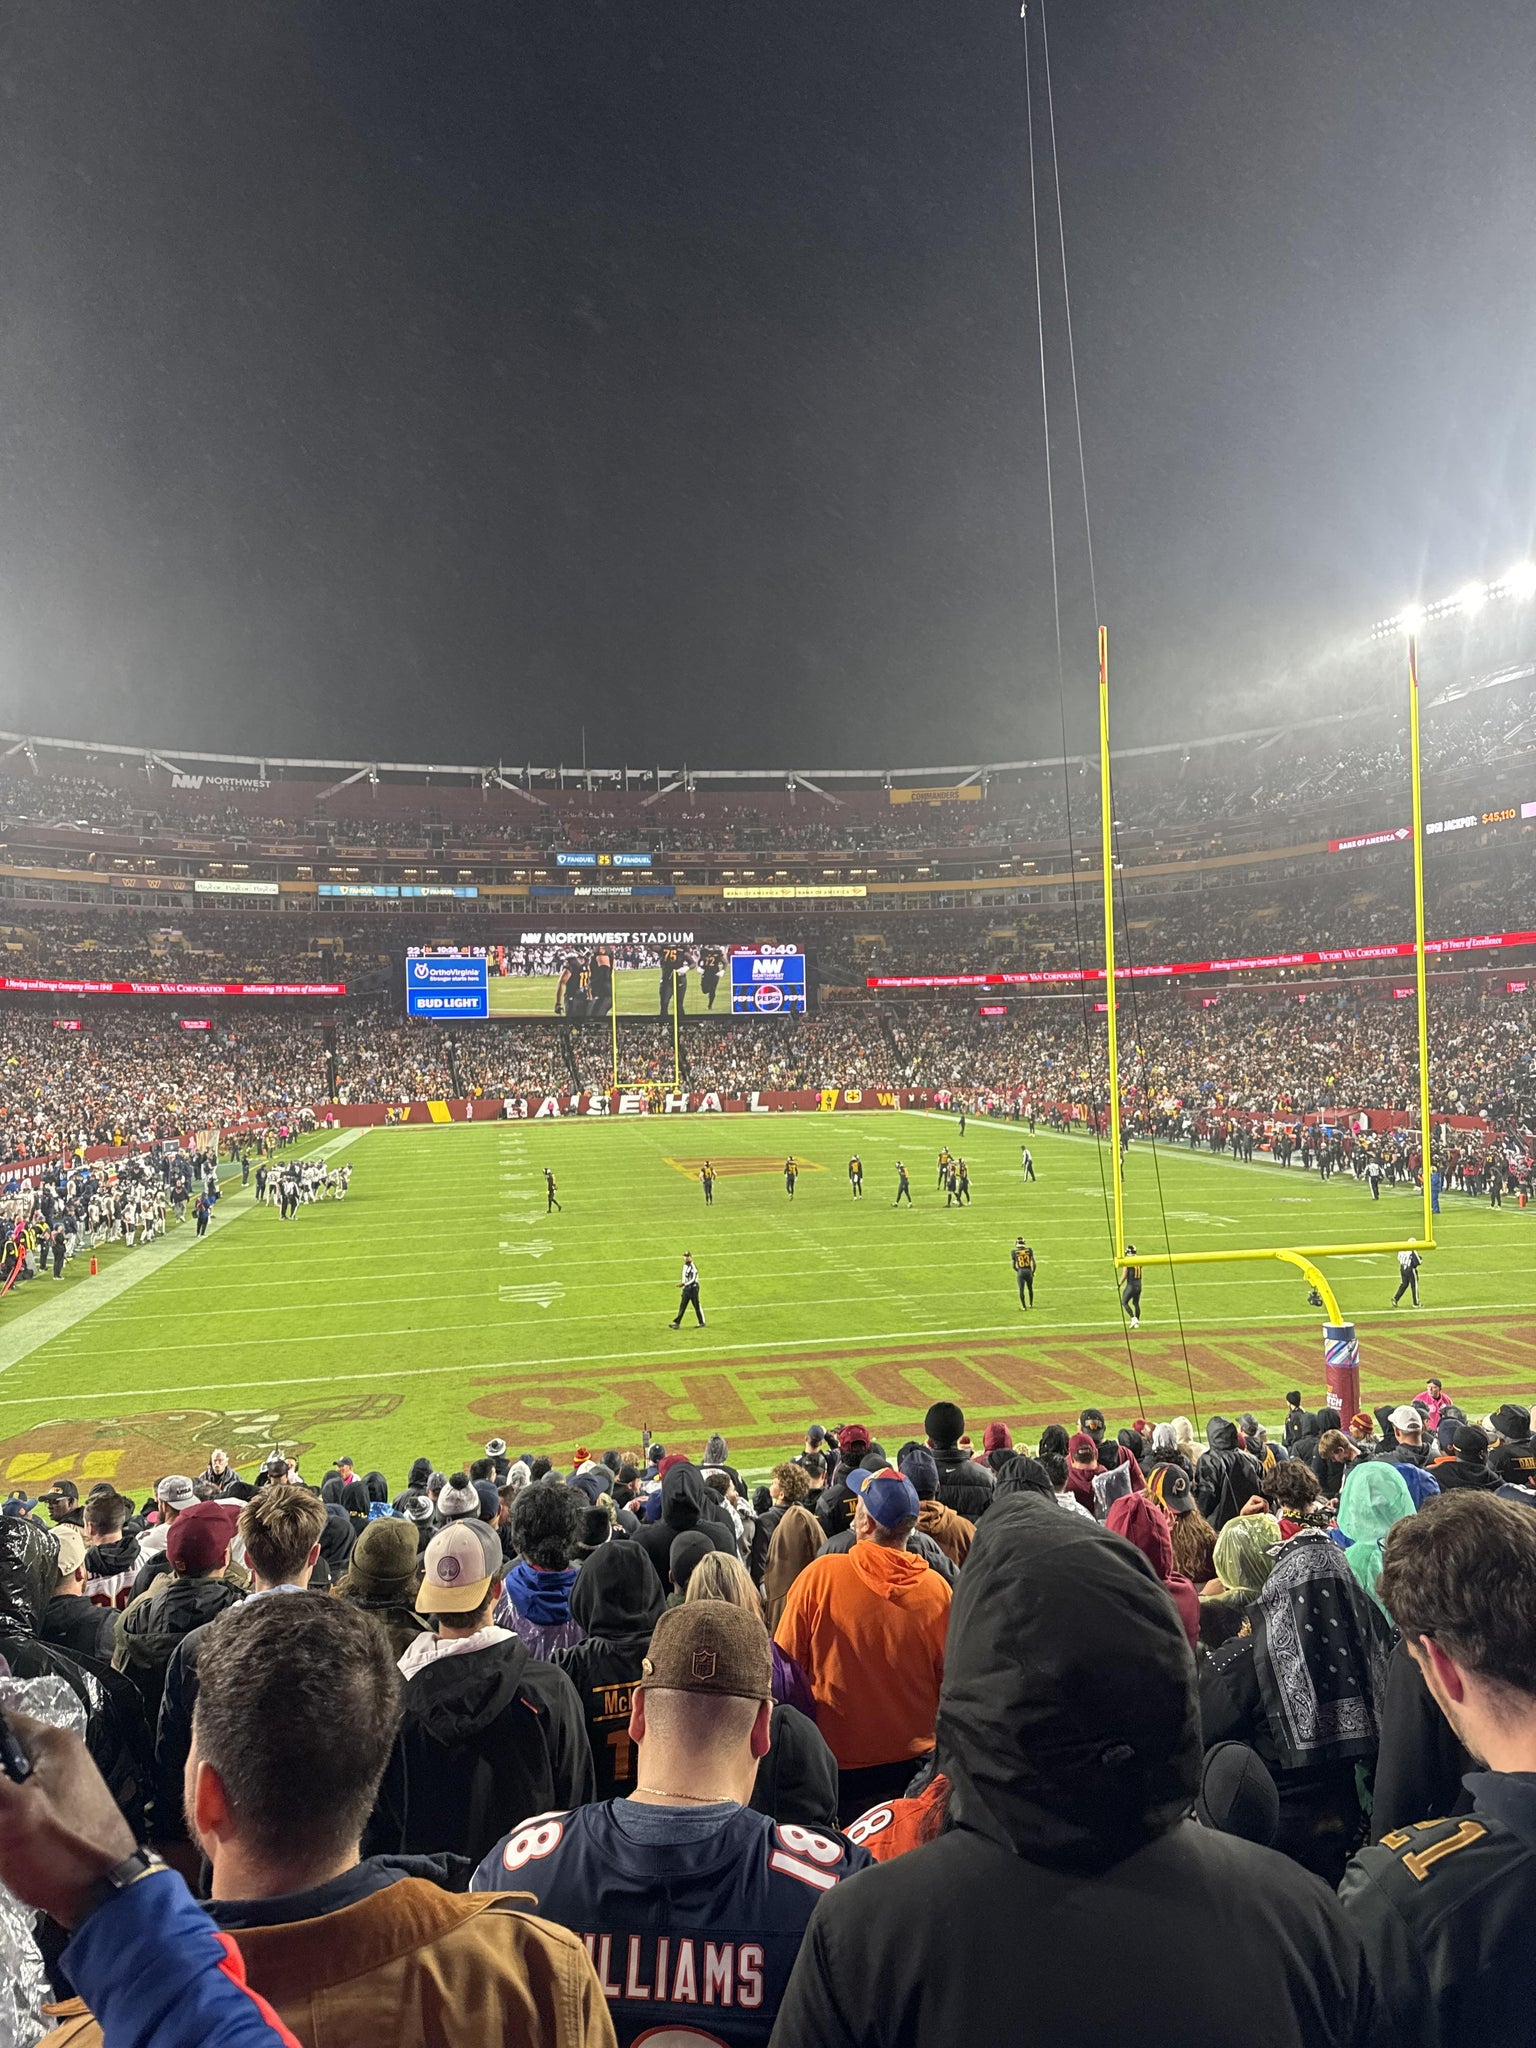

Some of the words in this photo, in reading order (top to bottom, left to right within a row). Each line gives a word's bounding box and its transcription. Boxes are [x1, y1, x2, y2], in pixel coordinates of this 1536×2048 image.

[205, 776, 271, 788] NORTHWEST
[911, 791, 960, 801] COMMANDERS
[1481, 809, 1516, 824] $45,110
[1338, 841, 1357, 850] BANK
[1357, 839, 1366, 847] OF
[1366, 833, 1396, 845] AMERICA
[544, 933, 631, 944] NORTHWEST
[632, 932, 694, 944] STADIUM
[1442, 941, 1449, 949] 75
[1450, 939, 1465, 948] Years
[1472, 936, 1502, 947] Excellence
[407, 946, 421, 954] 22
[473, 946, 487, 954] 24
[760, 944, 798, 955] 0:40
[1318, 951, 1343, 960] VICTORY
[1344, 950, 1356, 958] VAN
[1356, 947, 1398, 957] CORPORATION
[752, 959, 785, 974] NW
[429, 968, 480, 977] OrthoVirginia
[1002, 974, 1028, 982] VICTORY
[1029, 973, 1042, 981] VAN
[1042, 971, 1085, 980] CORPORATION
[58, 983, 83, 992] Company
[131, 983, 160, 993] VICTORY
[161, 984, 175, 992] VAN
[176, 984, 226, 993] CORPORATION
[242, 985, 275, 994] Delivering
[308, 985, 339, 993] Excellence
[417, 998, 443, 1008] BUD
[444, 998, 479, 1008] LIGHT
[664, 1091, 770, 1113] HAL
[768, 1824, 844, 1893] 18
[575, 1932, 765, 2010] ILLIAMS
